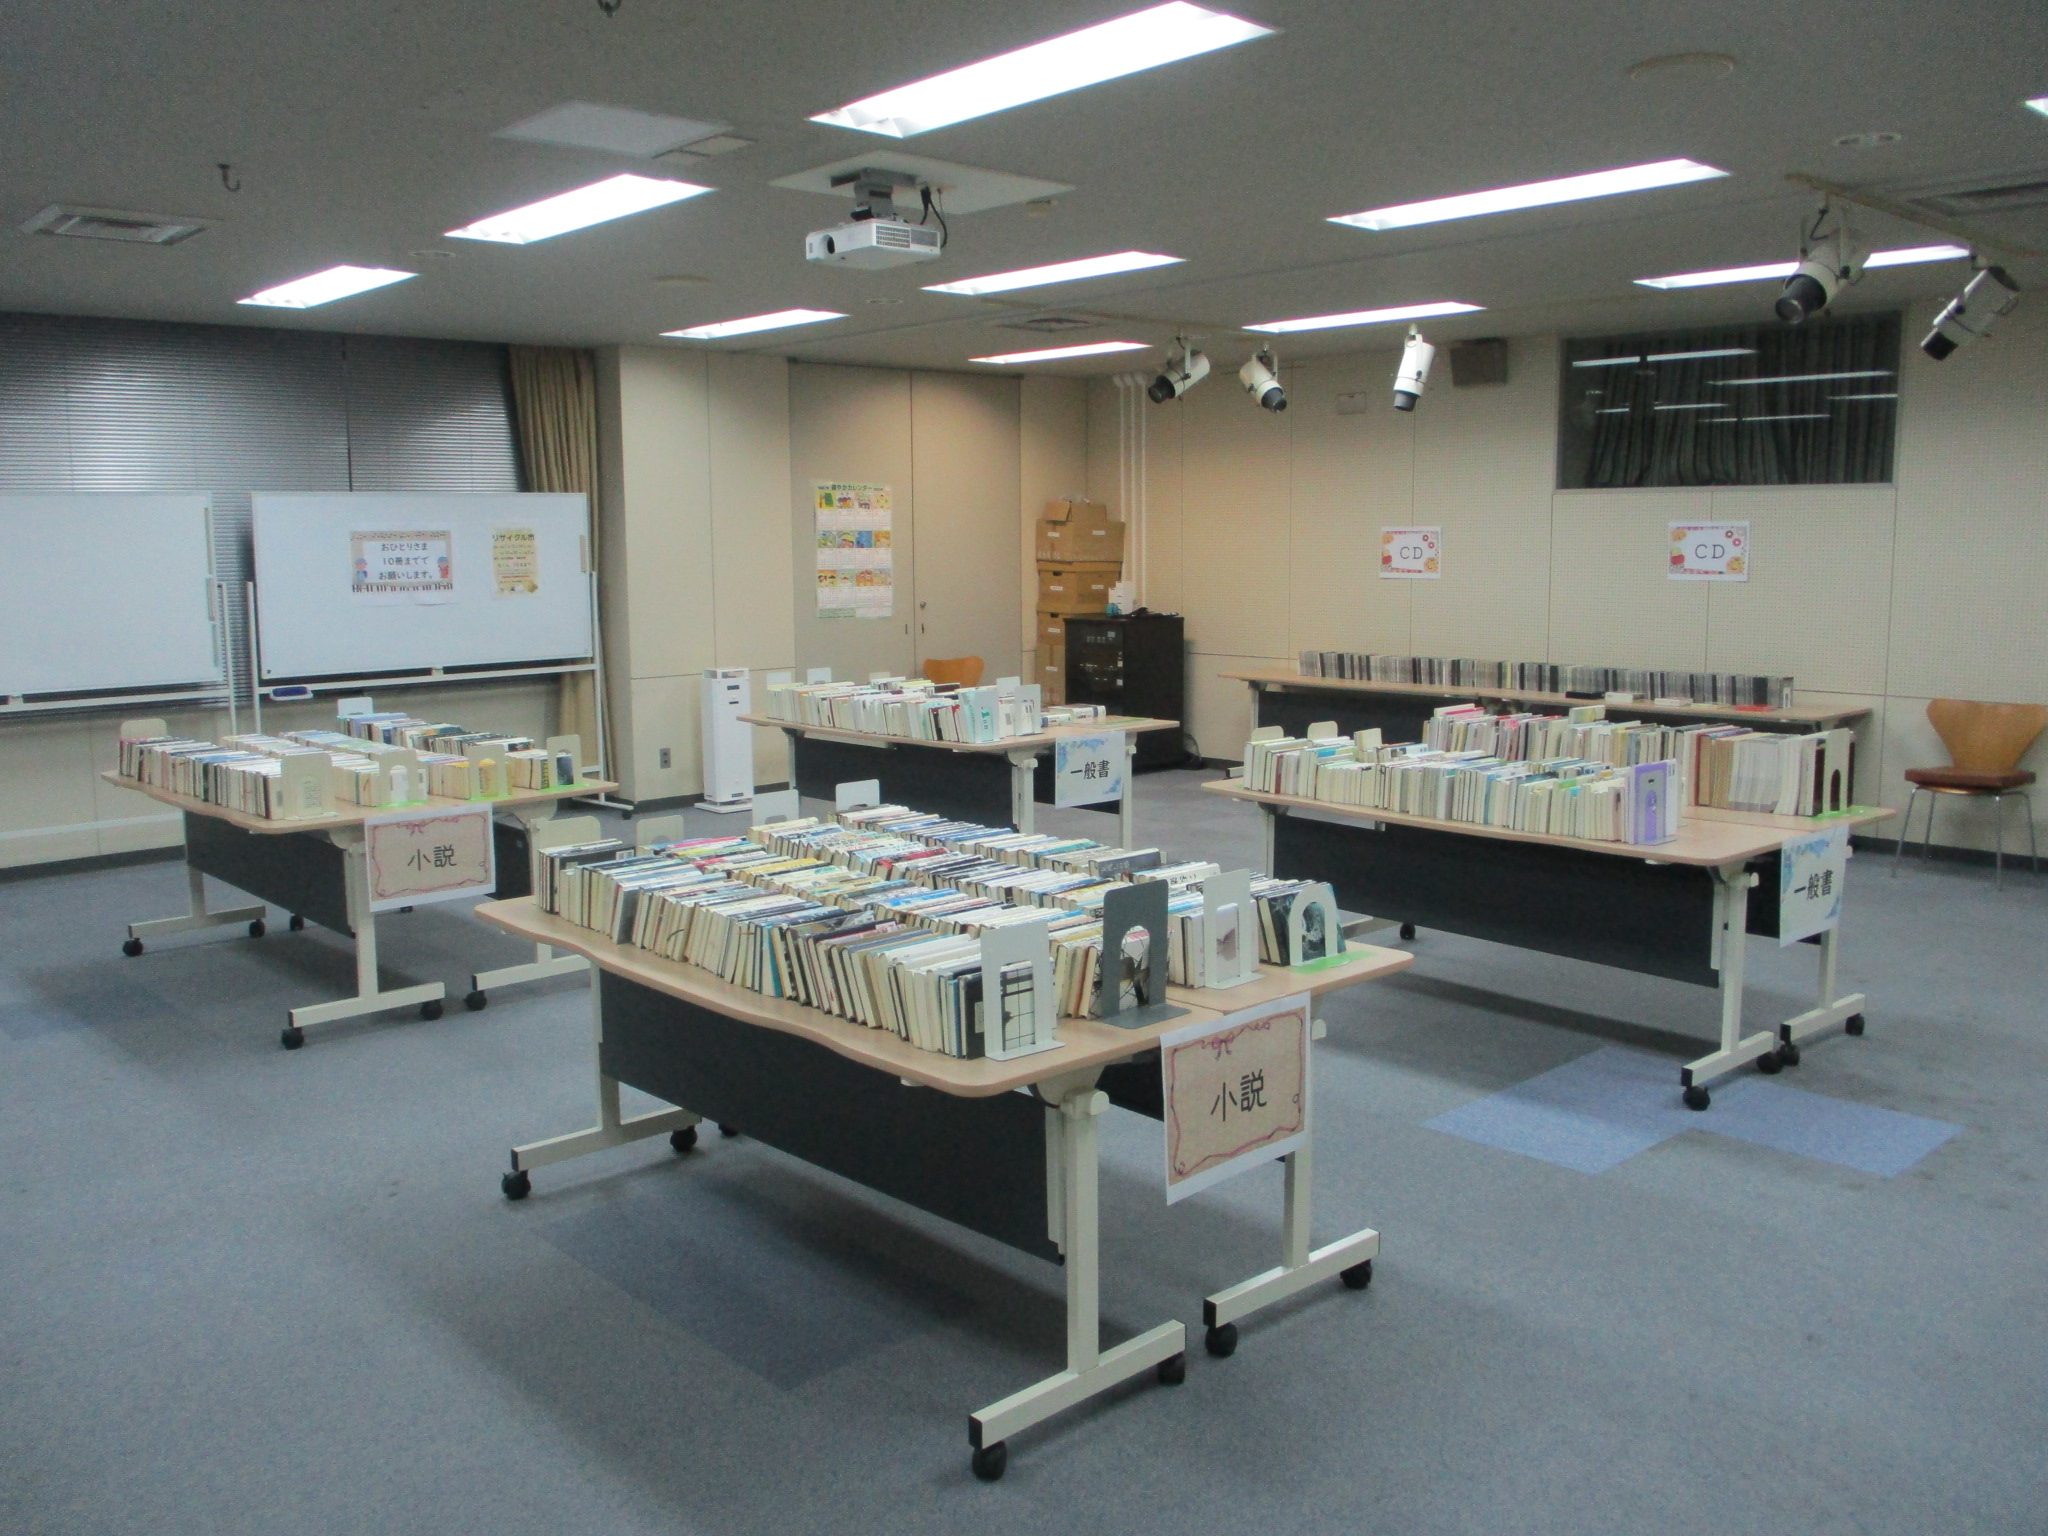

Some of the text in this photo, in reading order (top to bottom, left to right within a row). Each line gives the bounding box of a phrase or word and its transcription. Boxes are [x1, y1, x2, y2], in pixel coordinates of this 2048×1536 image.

[381, 542, 428, 551] おひとりさま
[1400, 546, 1423, 560] CD
[1694, 543, 1725, 559] CD
[379, 570, 433, 580] お願いします。
[1070, 759, 1110, 779] 一般書
[407, 844, 457, 871] 小説
[1793, 869, 1834, 900] 一般書
[1210, 1068, 1267, 1122] 小説
